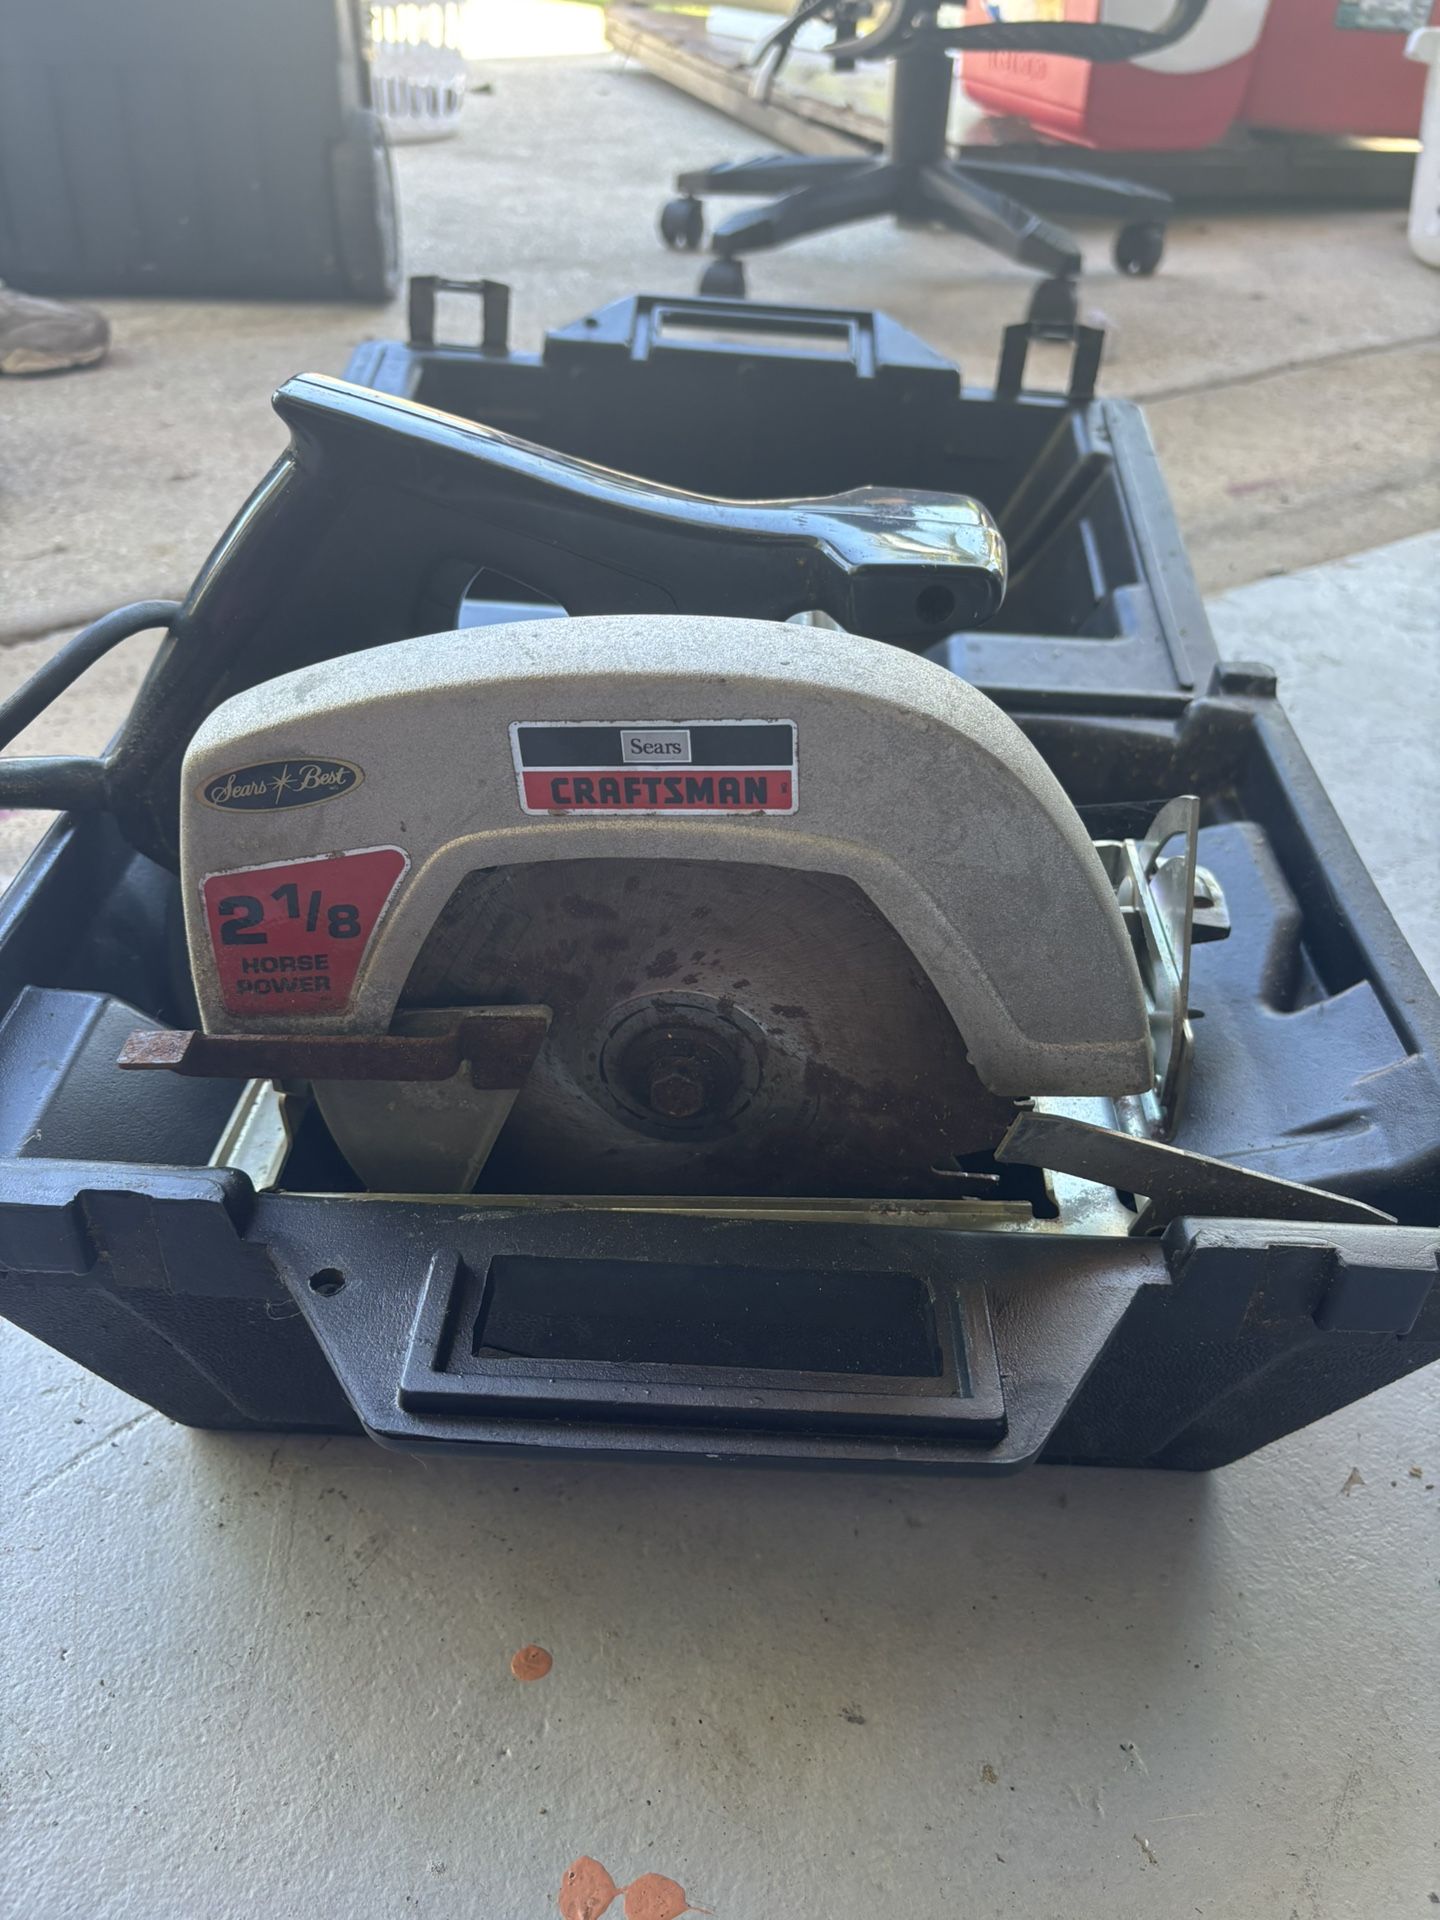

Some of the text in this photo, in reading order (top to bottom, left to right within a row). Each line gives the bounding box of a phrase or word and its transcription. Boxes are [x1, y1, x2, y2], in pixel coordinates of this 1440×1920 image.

[630, 738, 682, 755] Sears
[211, 764, 350, 803] Sears Best
[551, 777, 767, 804] CRAFTSMAN
[241, 954, 329, 973] HORSE
[236, 975, 331, 995] POWER
